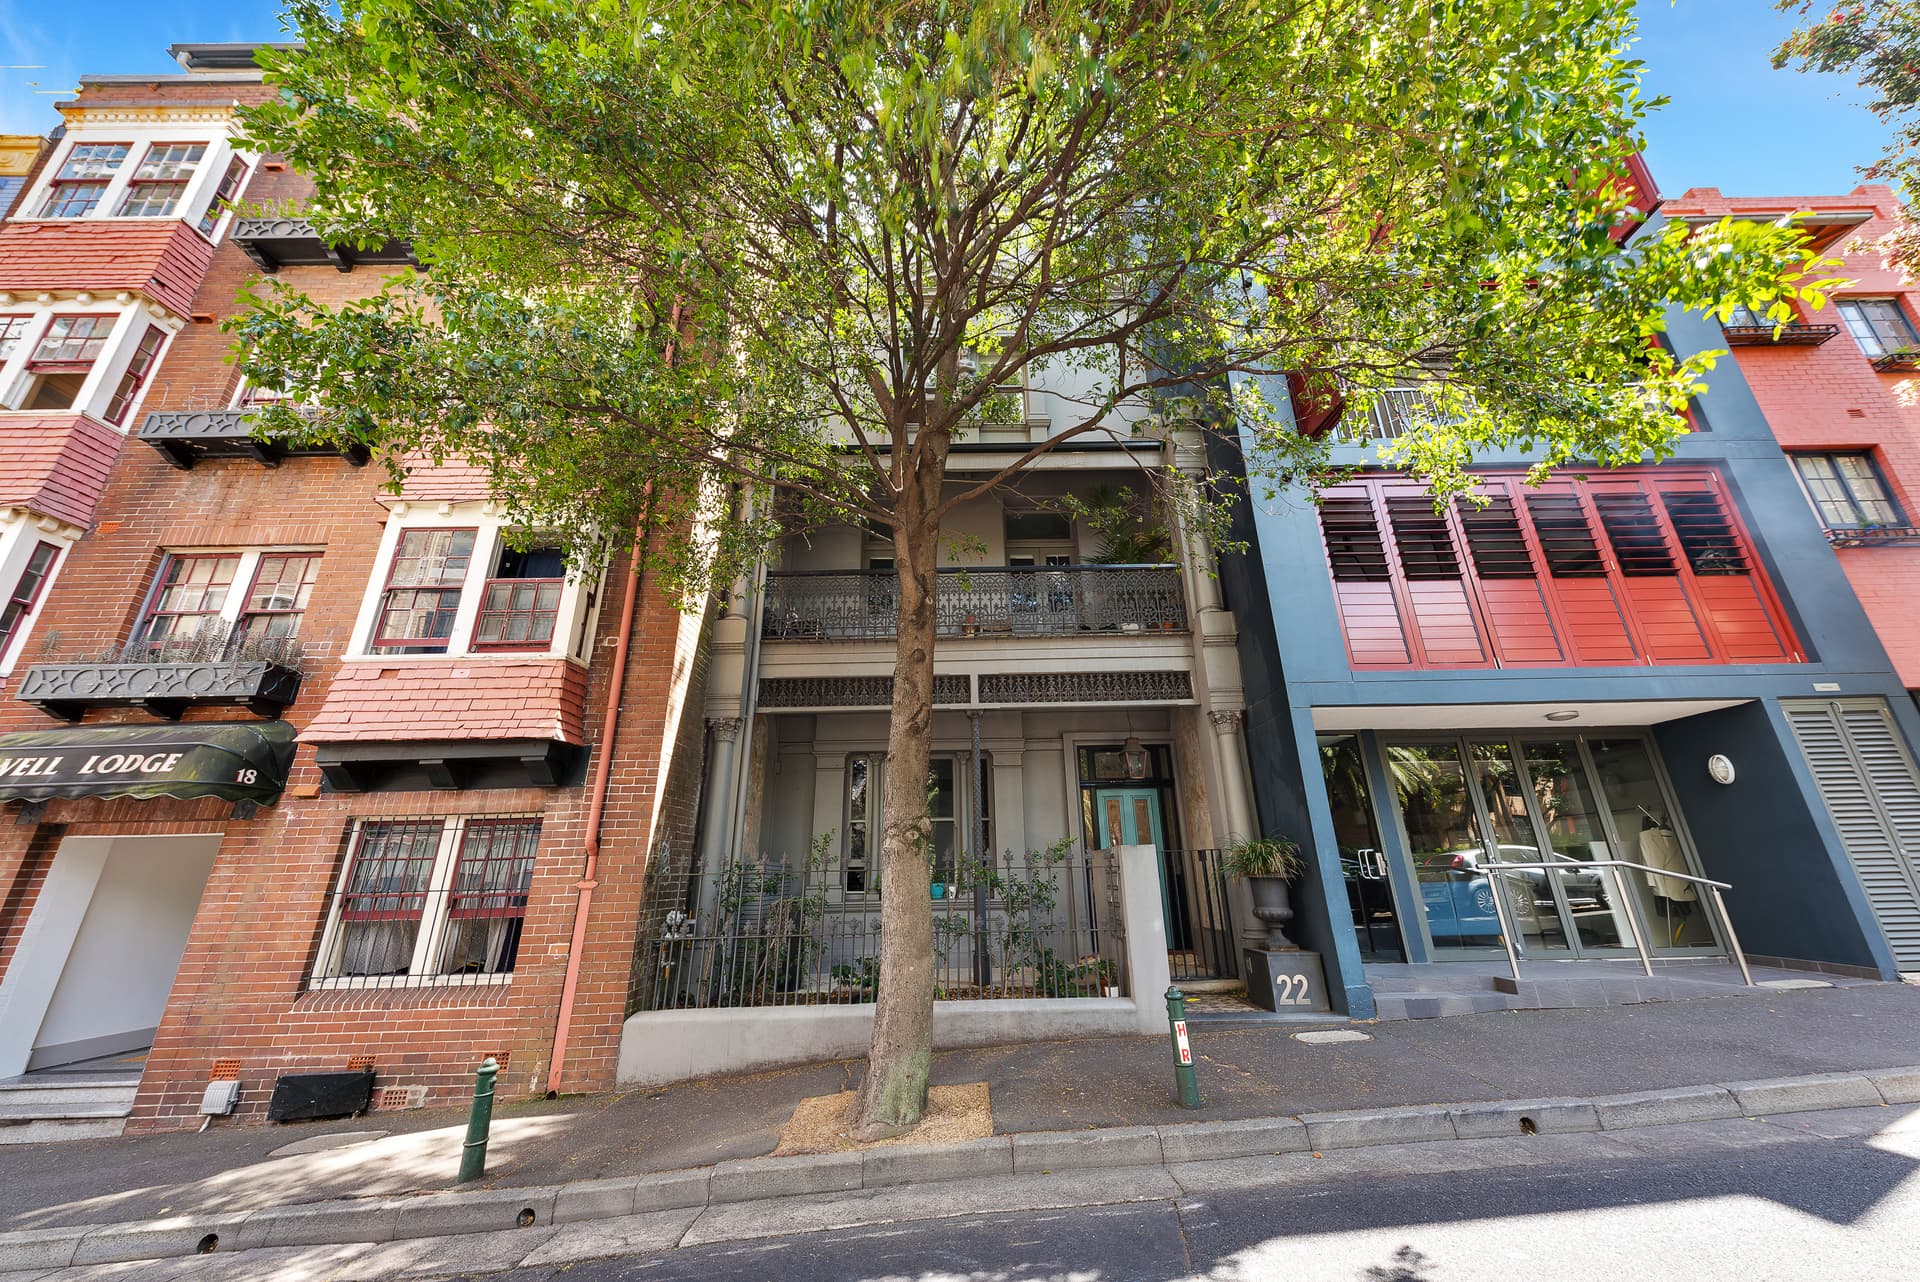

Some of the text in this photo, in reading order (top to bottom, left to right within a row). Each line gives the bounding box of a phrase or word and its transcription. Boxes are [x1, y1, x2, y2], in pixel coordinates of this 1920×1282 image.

[77, 753, 183, 774] LODGE
[236, 768, 258, 784] 18
[1277, 975, 1312, 1005] 22
